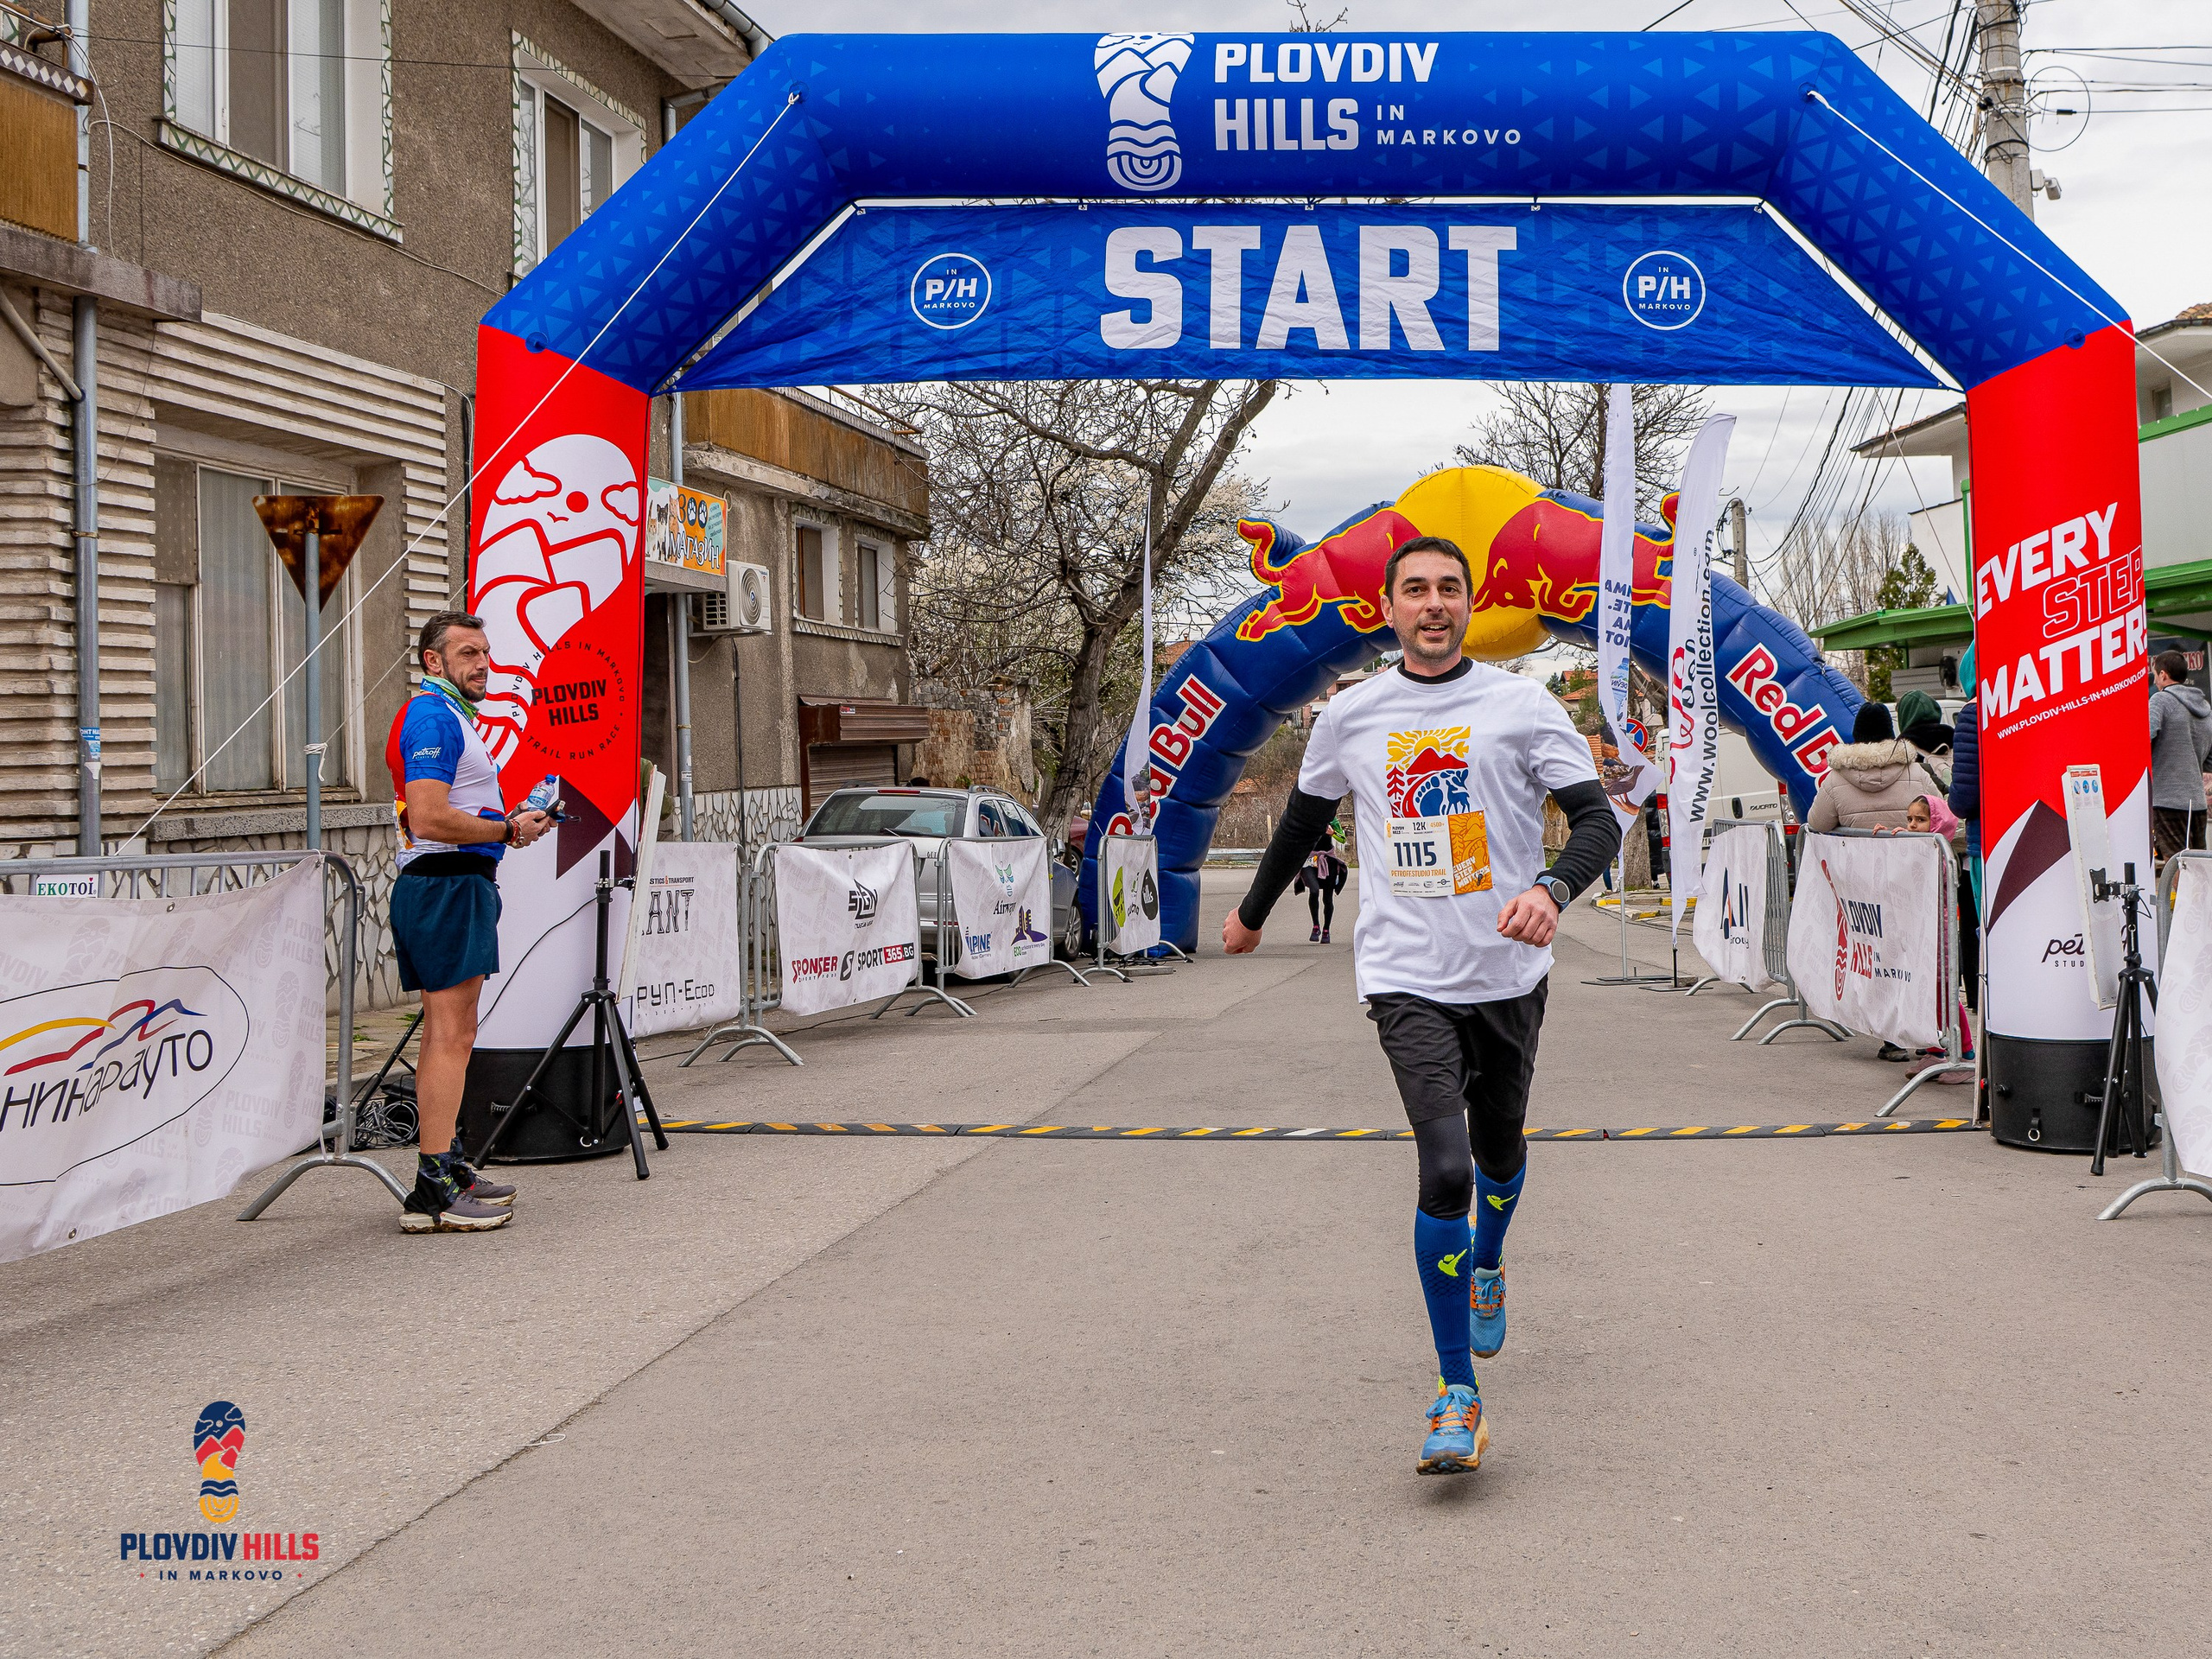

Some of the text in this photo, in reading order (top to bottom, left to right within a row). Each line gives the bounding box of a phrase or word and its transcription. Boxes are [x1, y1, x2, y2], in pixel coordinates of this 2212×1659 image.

[1214, 42, 1440, 83] PLOVDIV
[1214, 99, 1405, 150] HILLS IN
[1376, 129, 1522, 145] MARKOVO
[925, 277, 977, 301] P/H
[1100, 226, 1517, 351] START
[1638, 276, 1690, 301] P/H
[669, 531, 721, 569] МАГАЗИН
[1977, 502, 2118, 621] EVERY
[2043, 545, 2143, 639] STEP
[511, 641, 626, 717] PLOVDIV HILLS IN MARKOVO
[531, 679, 607, 706] PLOVDIV
[1689, 530, 1719, 823] www.woolcollection.com
[1728, 646, 1826, 742] Red
[548, 703, 600, 727] HILLS
[1149, 677, 1224, 770] Bull
[527, 724, 620, 760] TRAIL RUN RACE
[1412, 822, 1427, 831] 12K
[1394, 841, 1437, 867] 1115
[642, 889, 695, 936] ANT
[791, 956, 838, 984] SPONSER
